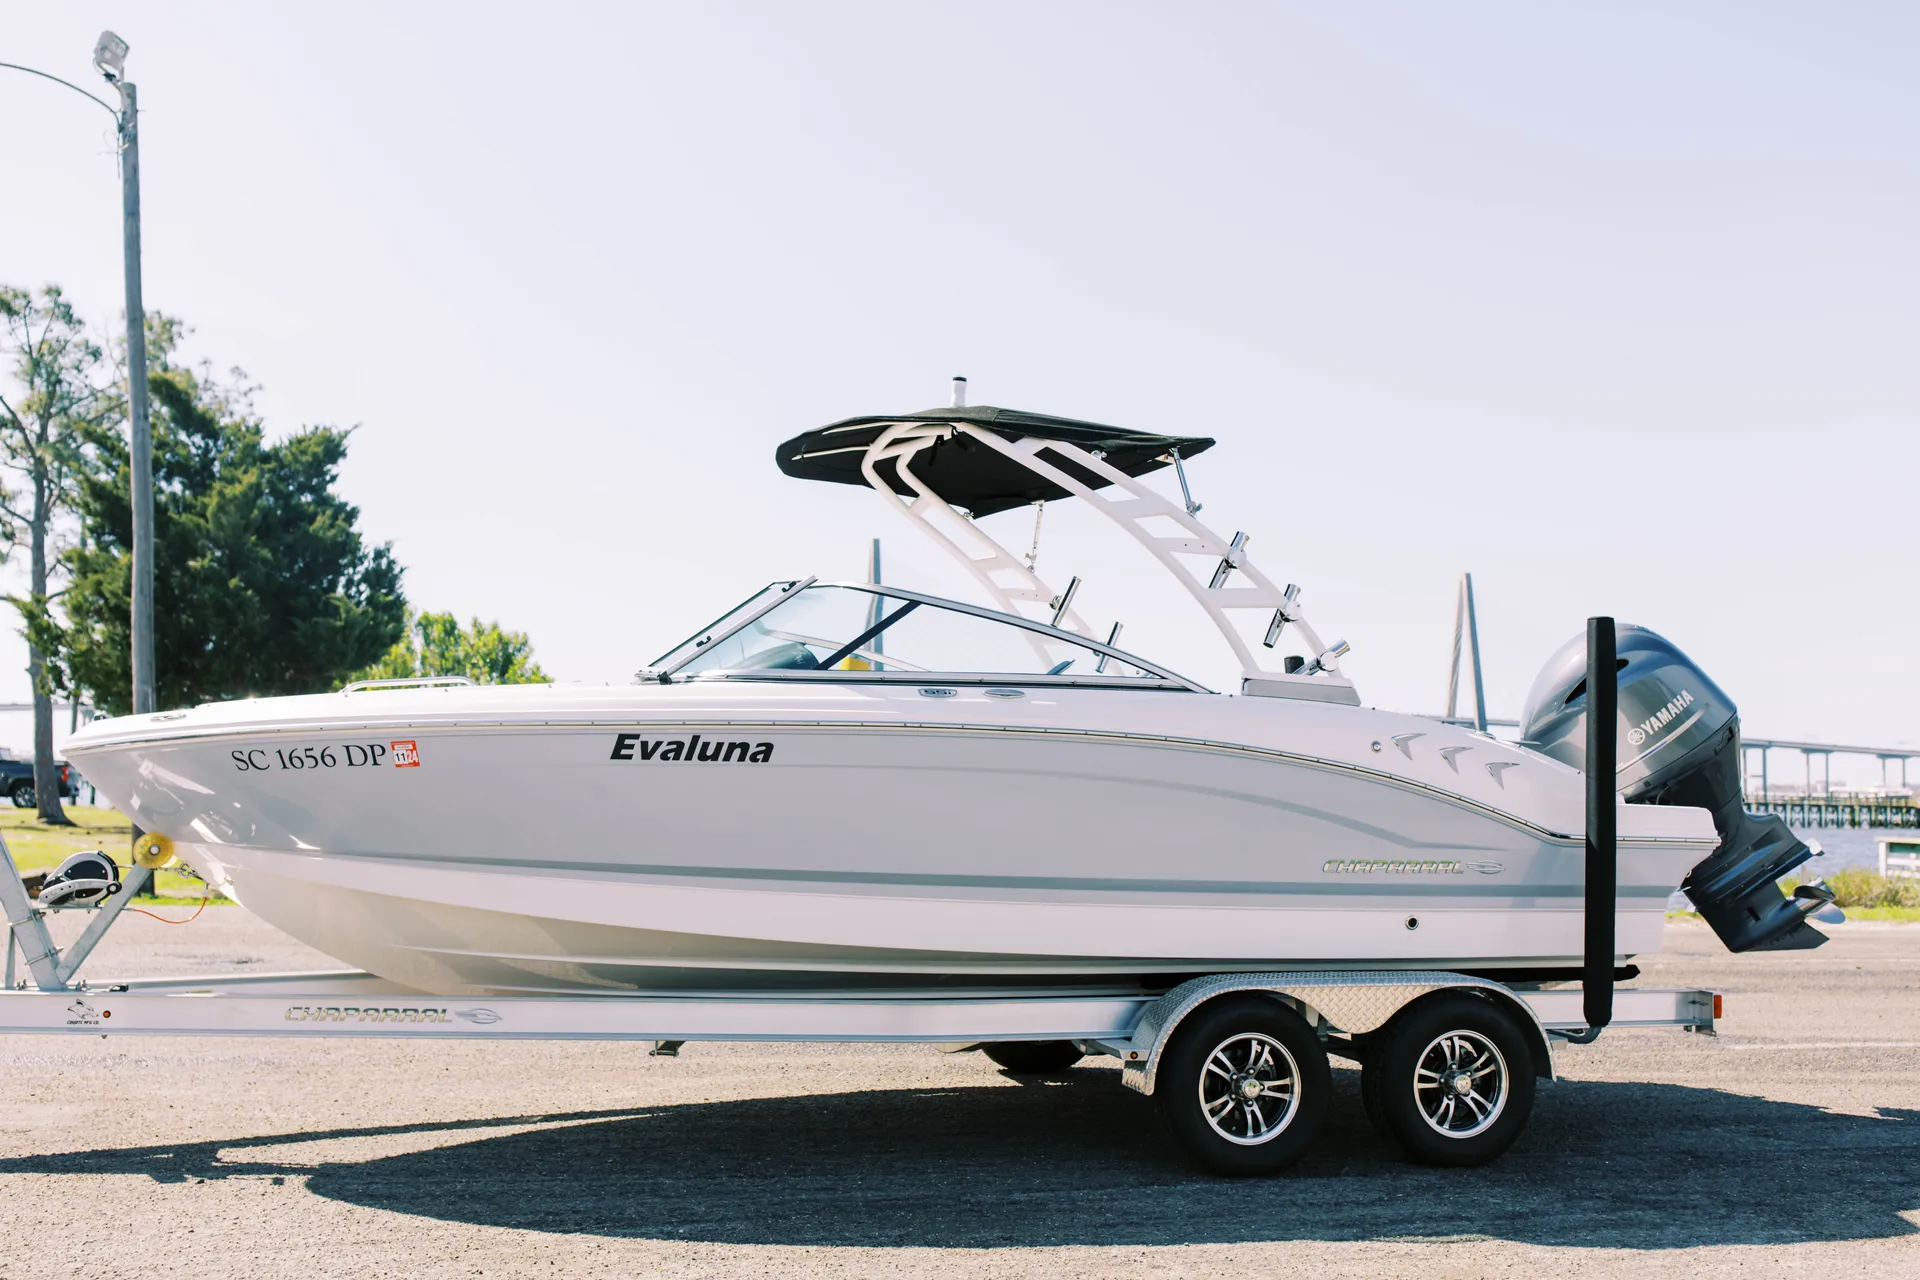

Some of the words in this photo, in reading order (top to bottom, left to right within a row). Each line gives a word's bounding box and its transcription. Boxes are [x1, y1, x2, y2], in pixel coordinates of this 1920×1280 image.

[1640, 689, 1694, 735] YAMAHA
[231, 750, 270, 771] SC
[275, 748, 336, 769] 1656
[342, 743, 386, 767] DP
[610, 733, 774, 763] Evaluna
[1322, 859, 1465, 874] CHAPARRAL
[284, 1006, 453, 1023] CHAPARRAL
